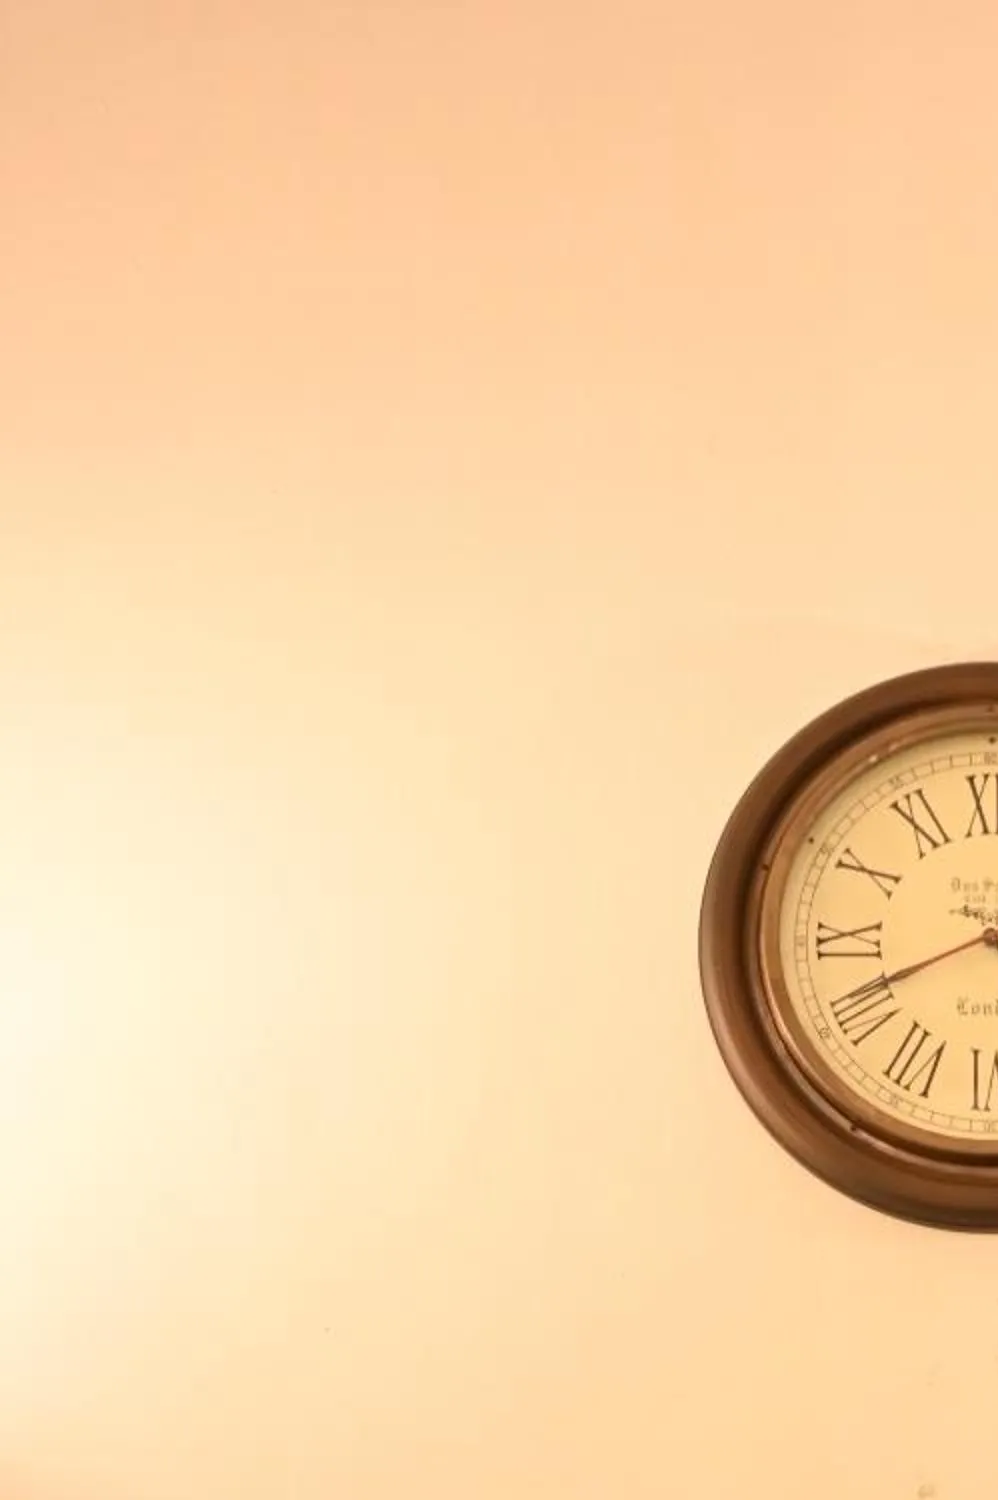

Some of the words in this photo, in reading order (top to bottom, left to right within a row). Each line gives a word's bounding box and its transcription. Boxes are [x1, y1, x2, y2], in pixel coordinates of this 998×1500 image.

[890, 788, 952, 859] XI
[834, 848, 902, 899] X
[816, 921, 882, 960] IX
[882, 1020, 947, 1098] VII
